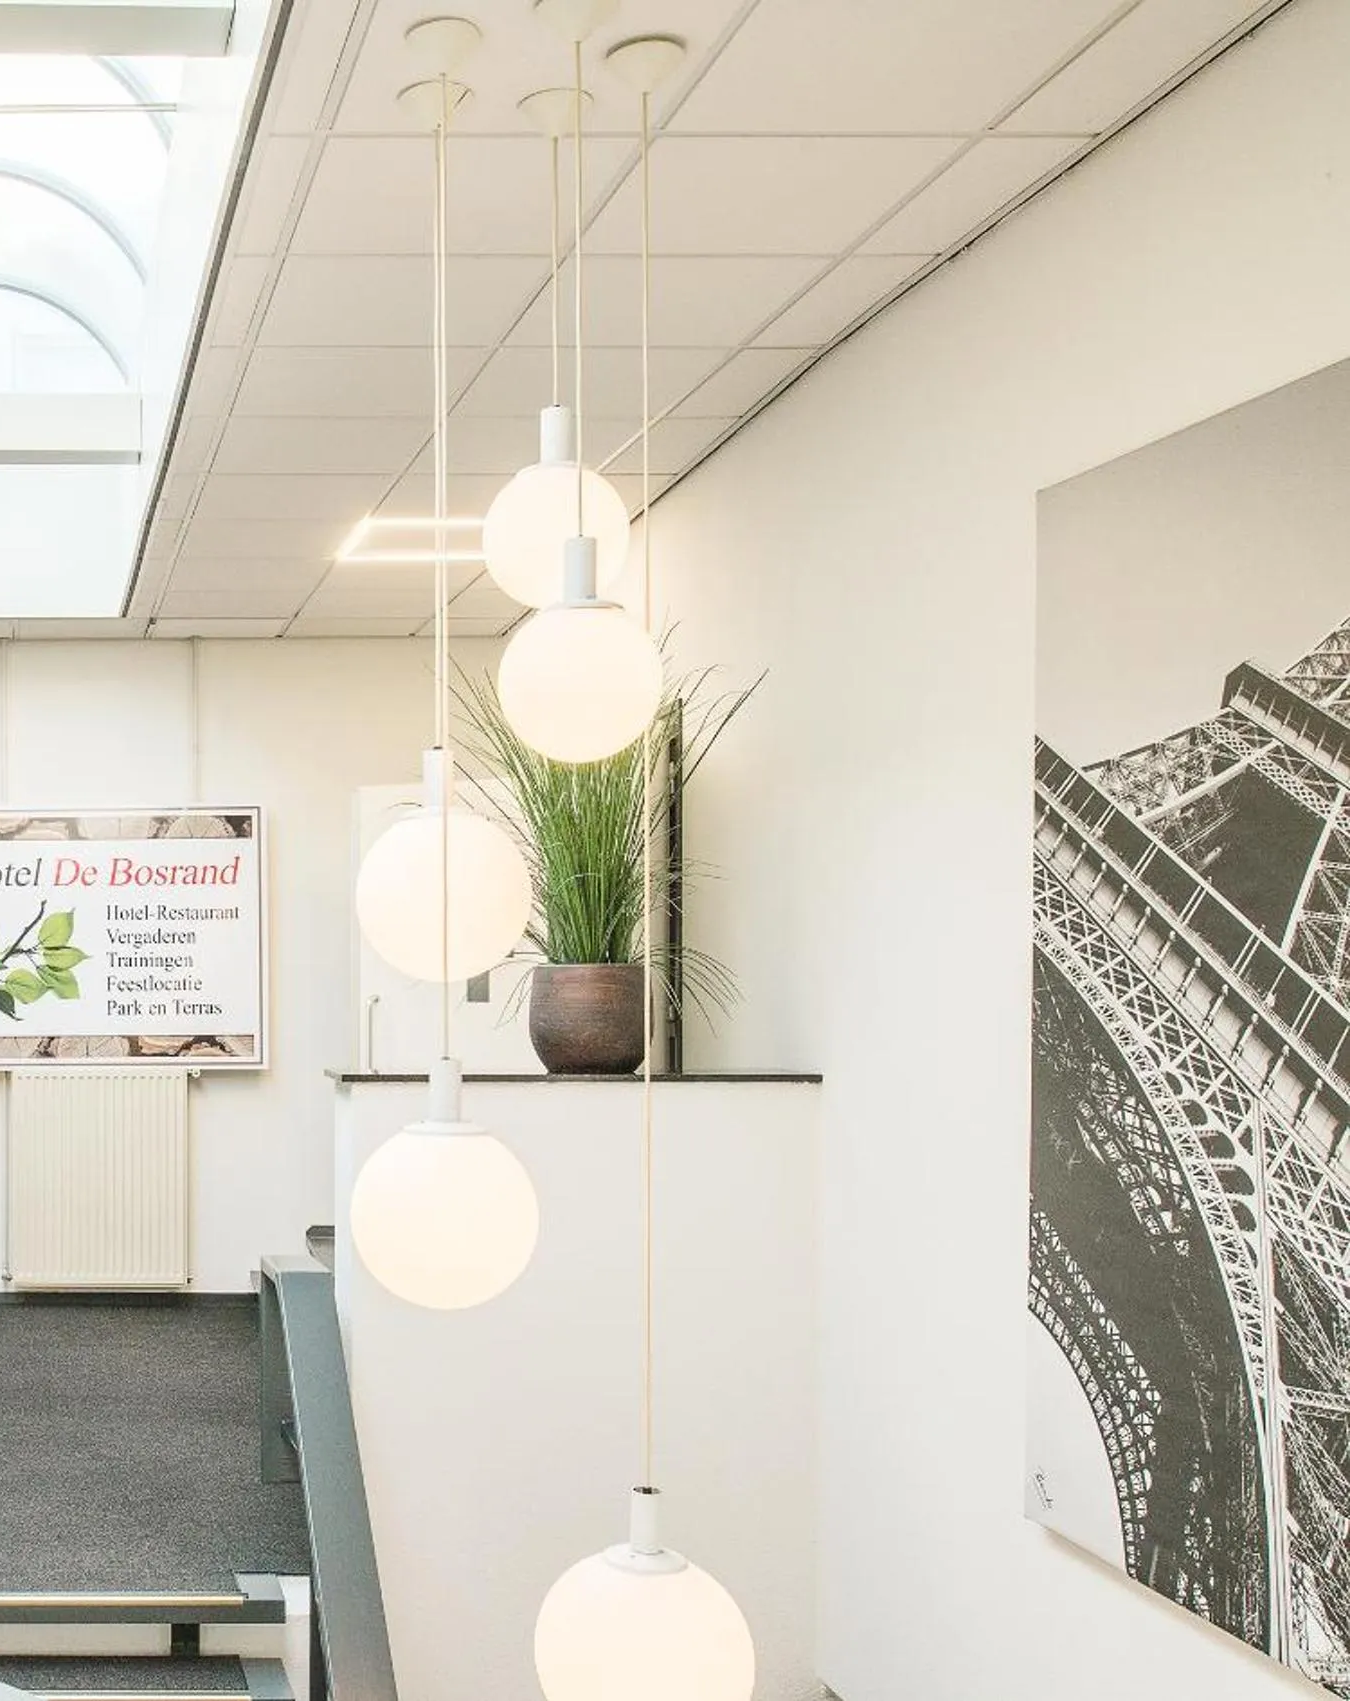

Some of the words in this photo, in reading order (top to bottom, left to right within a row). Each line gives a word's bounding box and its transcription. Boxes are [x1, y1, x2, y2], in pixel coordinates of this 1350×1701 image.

[53, 858, 98, 886] De
[108, 856, 241, 887] Bosrand
[106, 904, 240, 921] Hotel-Restaurant
[106, 929, 197, 948] Vergaderen
[106, 952, 195, 971] Trainingen
[106, 977, 203, 992] Feestlocatie
[106, 1001, 143, 1016] Park
[149, 1005, 167, 1016] en
[172, 1000, 224, 1016] Terras
